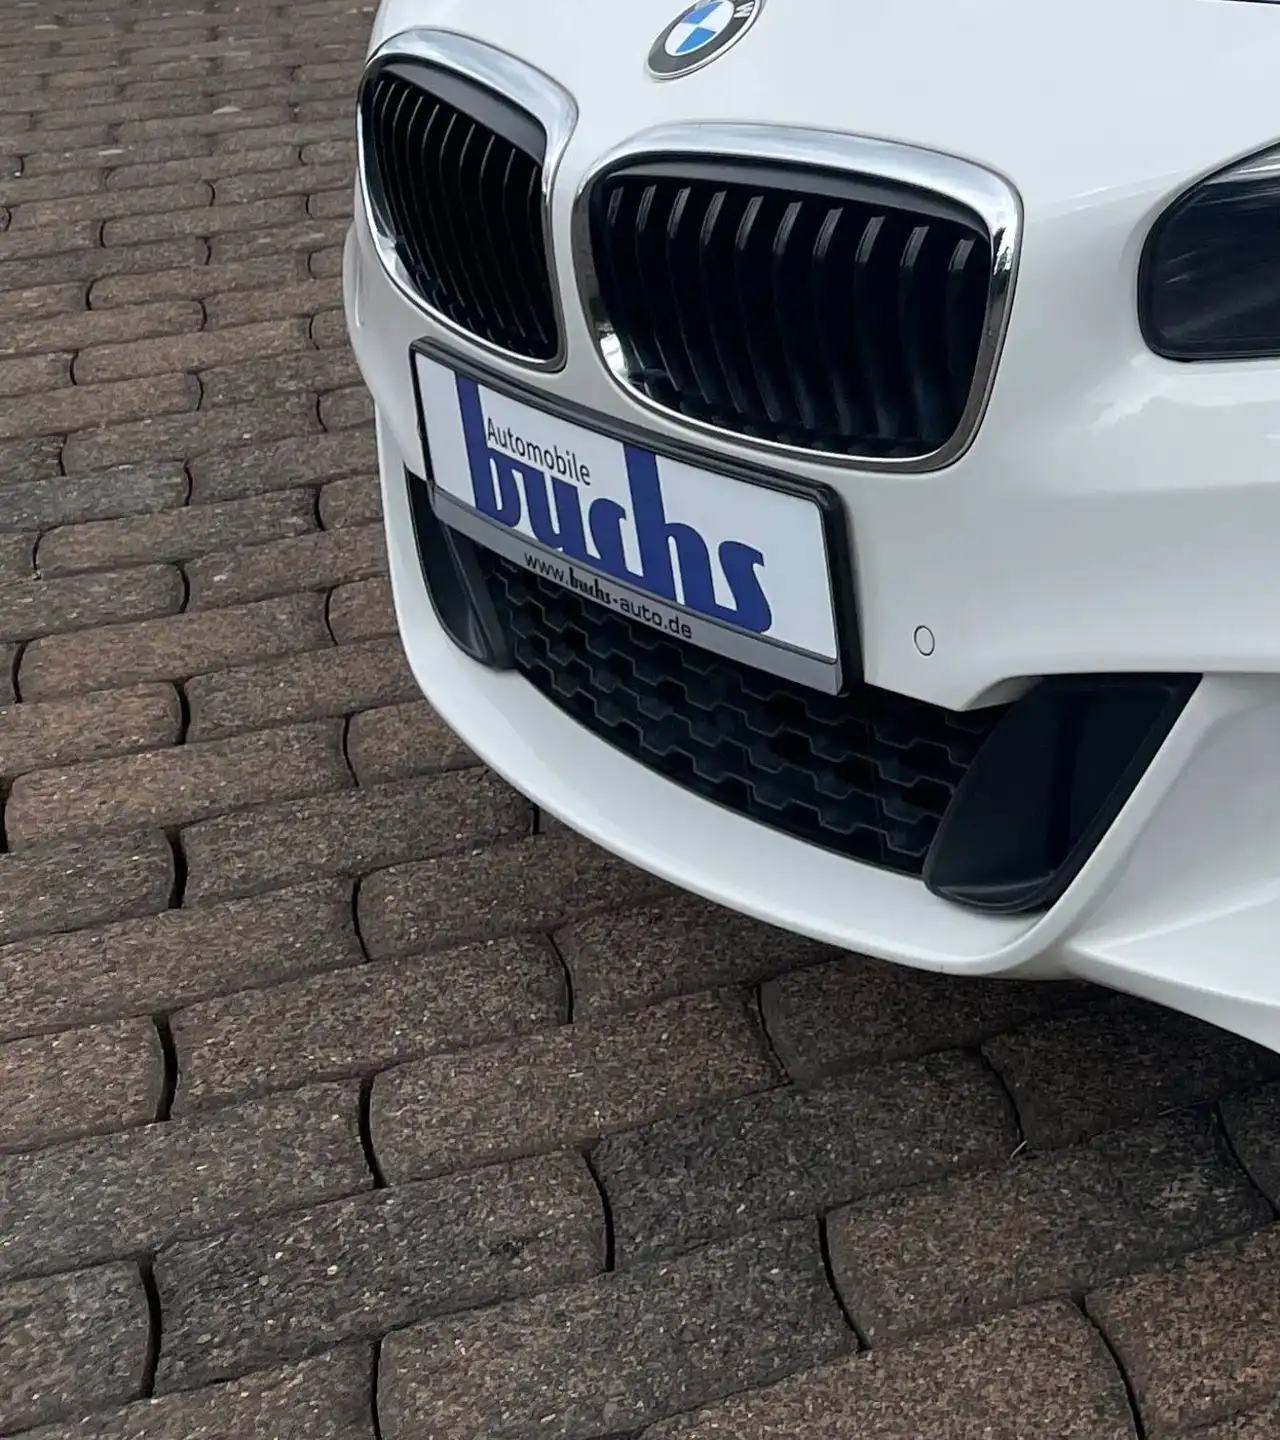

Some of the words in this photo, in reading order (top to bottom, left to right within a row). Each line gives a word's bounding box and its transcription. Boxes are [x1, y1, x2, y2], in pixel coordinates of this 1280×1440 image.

[486, 416, 591, 486] Automobile
[456, 371, 772, 633] buchs
[524, 552, 693, 639] www.buchs-auto.de
